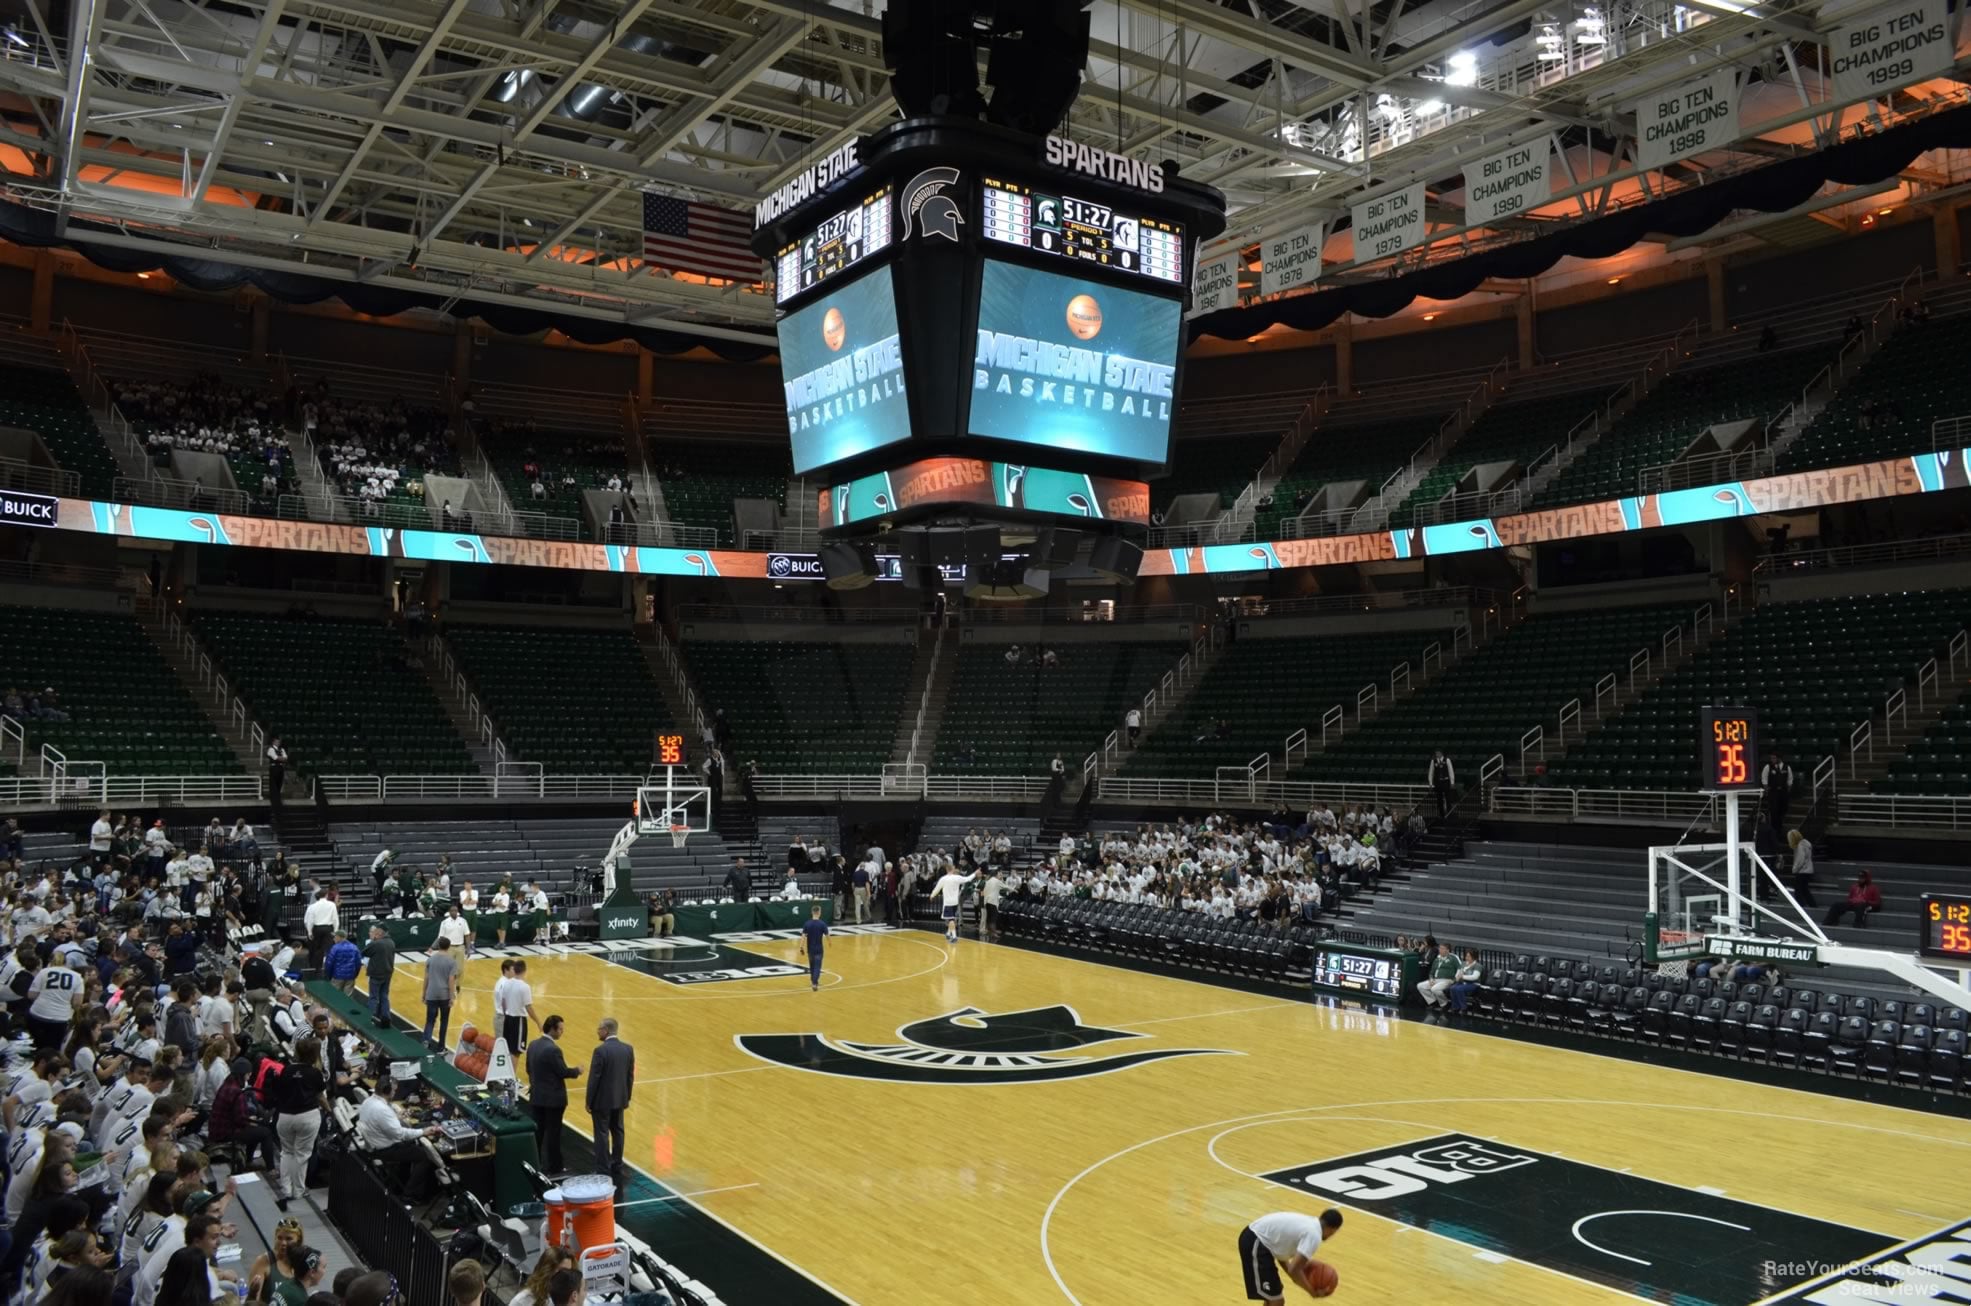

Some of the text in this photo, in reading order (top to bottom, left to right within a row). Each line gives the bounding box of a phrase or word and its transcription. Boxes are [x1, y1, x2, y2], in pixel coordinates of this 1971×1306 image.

[1850, 9, 1924, 48] BIG TEN
[1834, 24, 1945, 75] CHAMPIONS
[1866, 60, 1913, 86] 1999
[1658, 86, 1713, 119] BIG TEN
[1646, 101, 1728, 142] CHAMPIONS
[1669, 130, 1705, 155] 1998
[1046, 135, 1164, 193] SPARTANS
[1483, 149, 1531, 177] BIG TEN
[755, 166, 816, 230] MICHIGAN
[817, 136, 859, 188] STATE
[1473, 166, 1542, 202] CHAMPIONS
[1063, 200, 1110, 228] 51:27
[1368, 193, 1409, 220] BIG TEN
[1493, 194, 1523, 217] 1990
[817, 214, 846, 245] 51:27
[1359, 210, 1419, 242] CHAMPIONS
[851, 243, 857, 260] 0
[1042, 232, 1052, 250] 0
[1273, 234, 1309, 256] BIG TEN
[1376, 236, 1402, 255] 1979
[1121, 251, 1131, 268] 0
[1210, 262, 1226, 277] TEN
[1265, 246, 1318, 274] CHAMPIONS
[805, 269, 812, 286] 0
[784, 334, 903, 410] MICHIGAN STATE
[973, 329, 1175, 398] MICHIGAN STATE
[789, 374, 905, 433] BASKETBALL
[973, 370, 1169, 421] BASKETBALL
[899, 461, 985, 508] SPARTANS
[1750, 460, 1921, 511] SPARTANS
[4, 501, 51, 519] BUICK
[1498, 502, 1620, 545] SPARTANS
[225, 517, 369, 554] SPARTANS
[486, 537, 609, 571] SPARTANS
[1277, 533, 1395, 567] SPARTANS
[659, 736, 683, 746] 51:27
[1714, 720, 1747, 742] 51:27
[662, 746, 680, 762] 35
[1719, 745, 1746, 783] 35
[608, 917, 639, 930] xfinity
[1343, 959, 1372, 974] 51:27
[1735, 944, 1765, 957] FARM
[1766, 948, 1813, 961] BUREAU
[46, 971, 74, 990] 20
[496, 1055, 506, 1067] S
[587, 1261, 622, 1272] GATORADE
